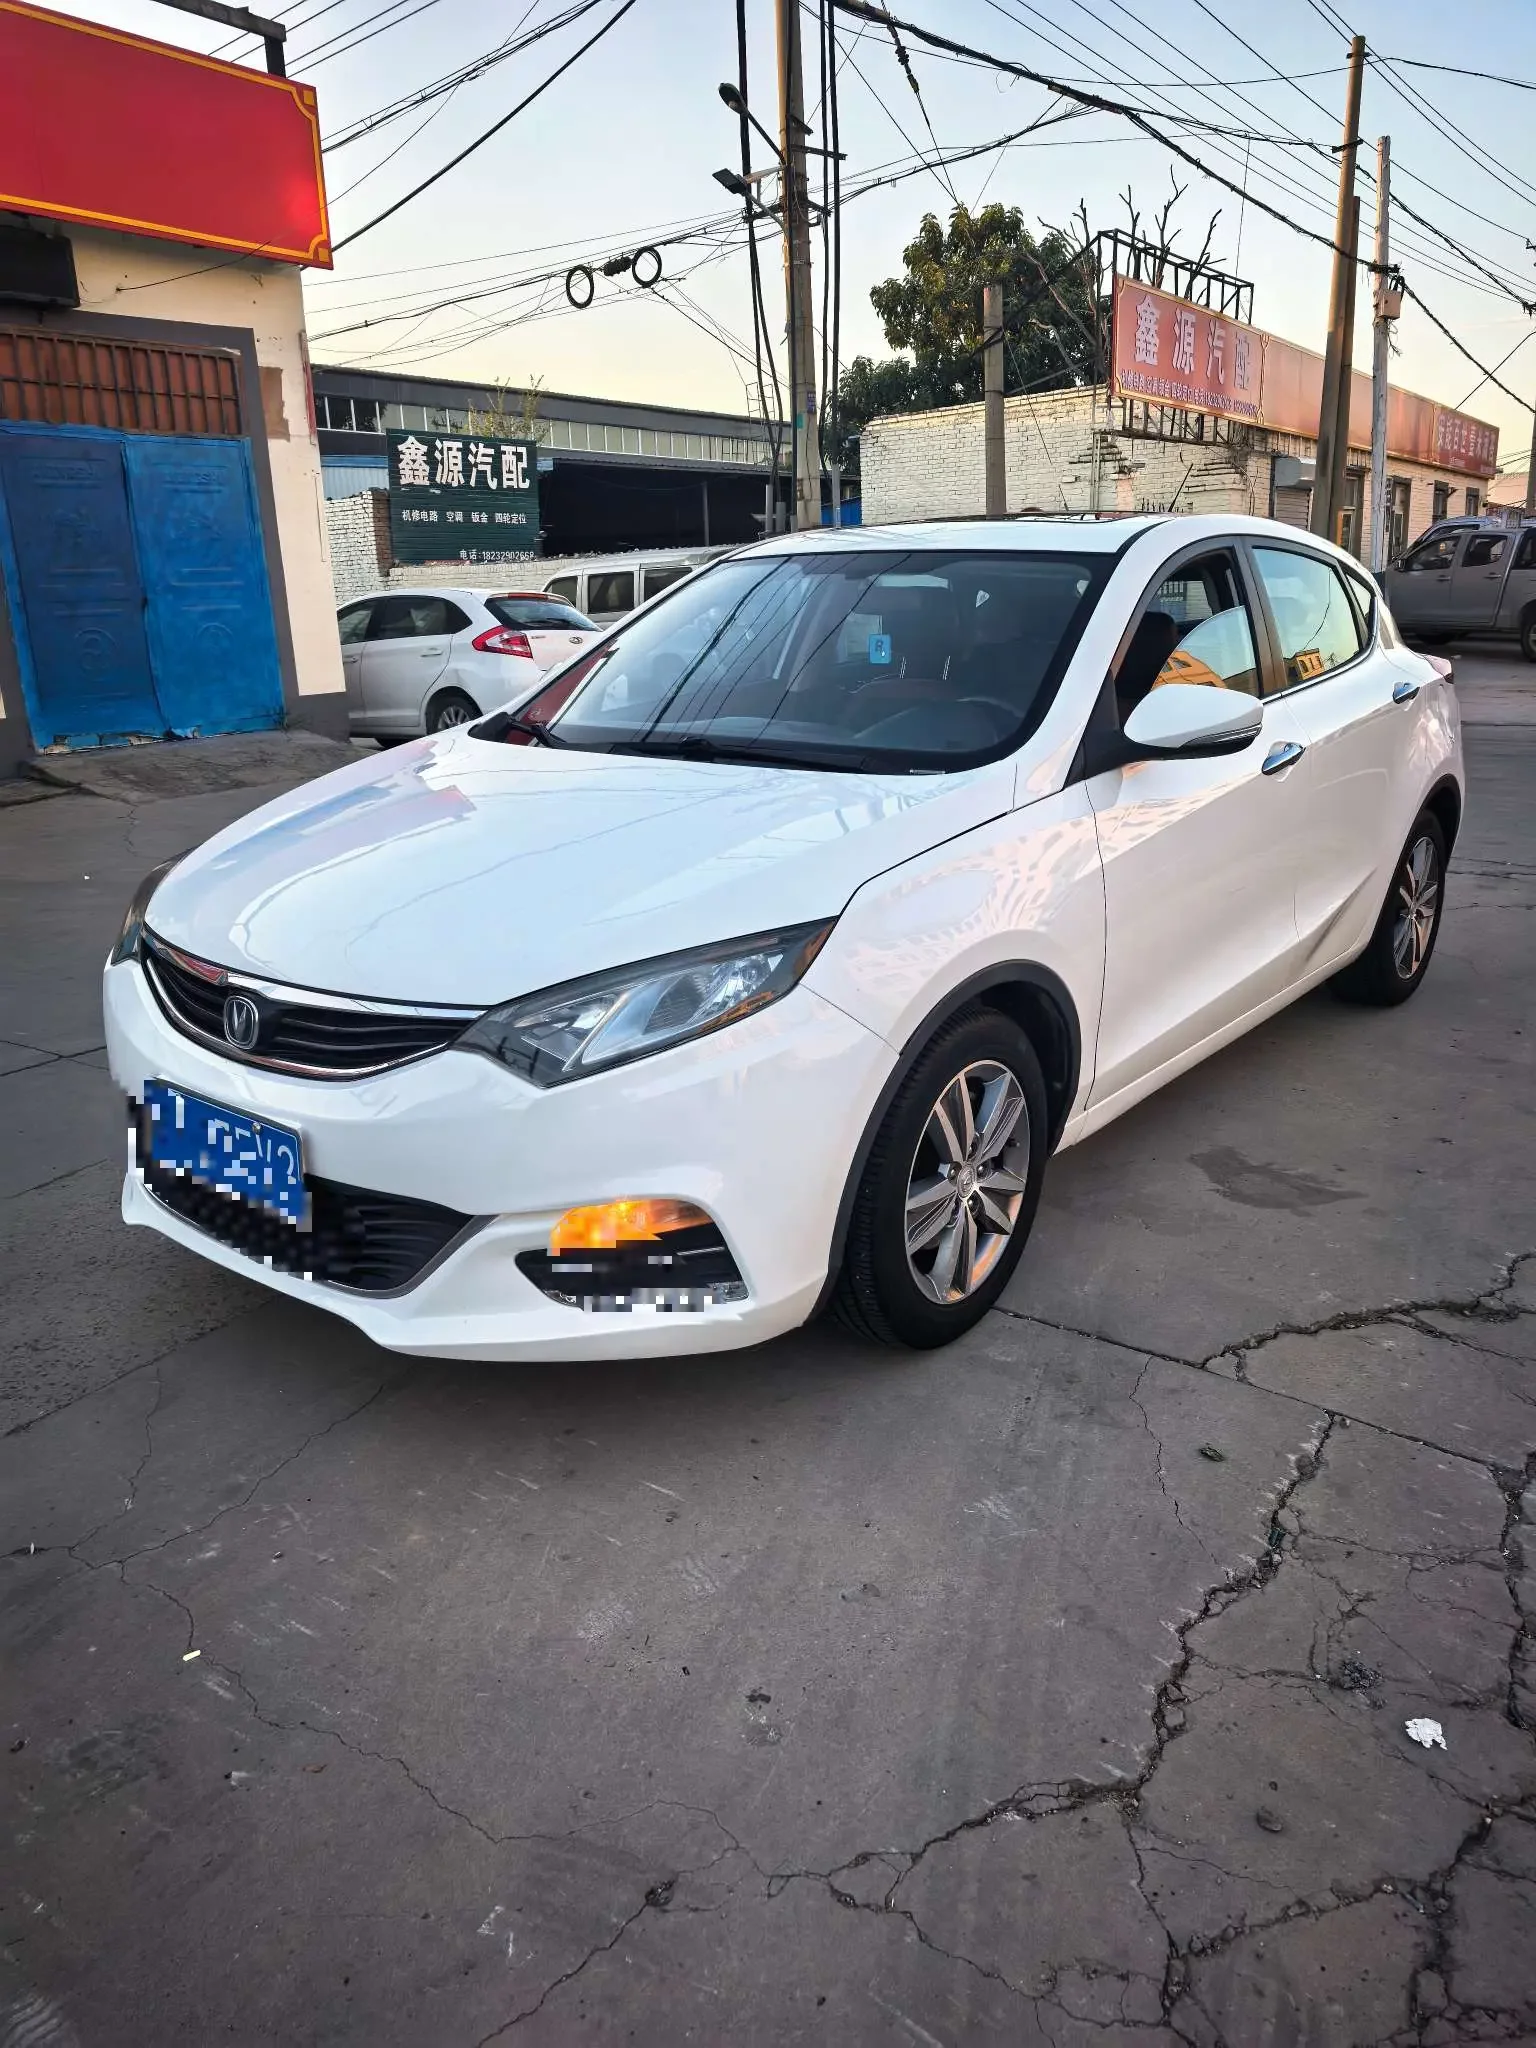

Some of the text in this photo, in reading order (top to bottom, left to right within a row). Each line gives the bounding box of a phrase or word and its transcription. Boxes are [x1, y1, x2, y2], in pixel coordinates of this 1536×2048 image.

[1134, 295, 1249, 390] 鑫源汽配
[397, 435, 531, 490] 鑫源汽配
[402, 509, 527, 524] 机修电路 空调 钣金 四轮定位
